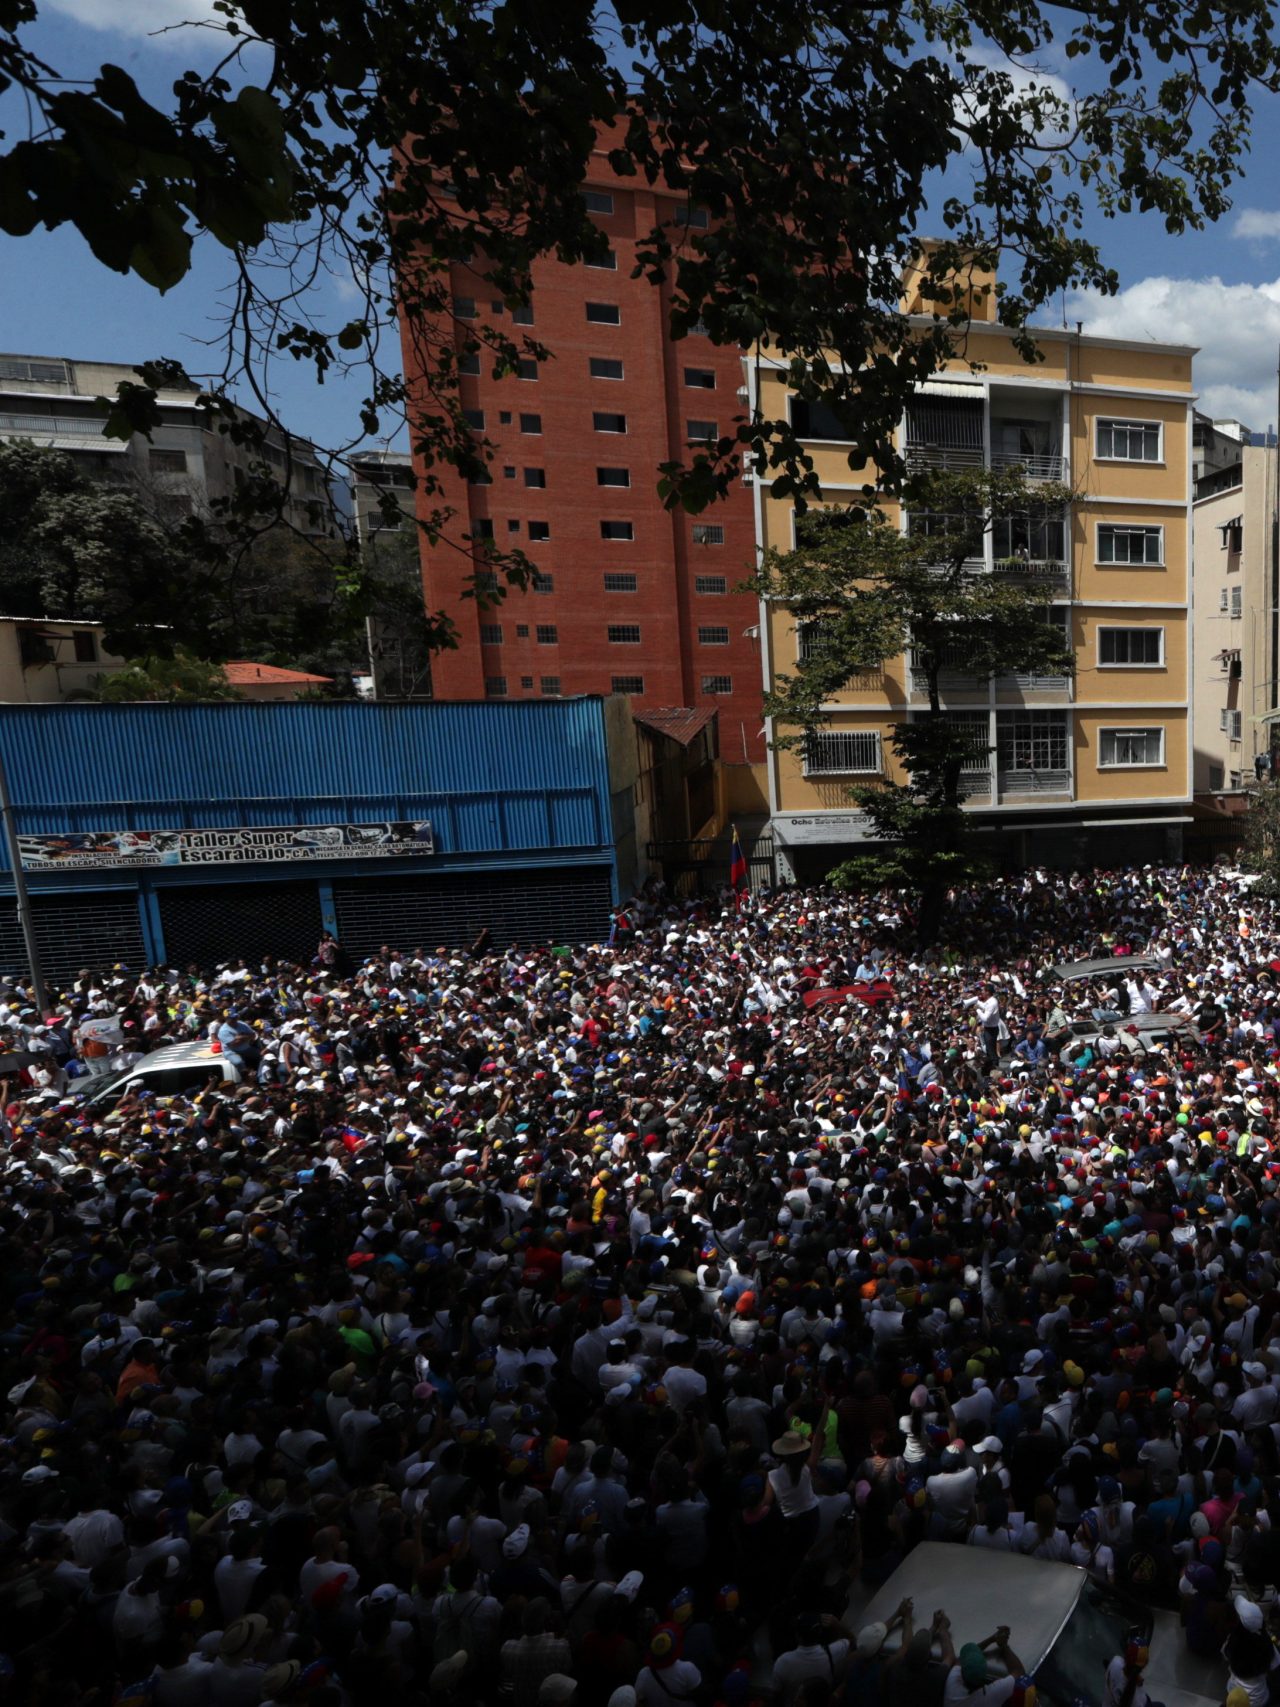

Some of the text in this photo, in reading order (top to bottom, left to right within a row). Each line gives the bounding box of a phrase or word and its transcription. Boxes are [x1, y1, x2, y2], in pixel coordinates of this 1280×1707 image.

[852, 816, 871, 824] 2007
[183, 831, 294, 847] Taller Super
[180, 847, 290, 862] Escarabajo,
[27, 861, 54, 869] TUBOS
